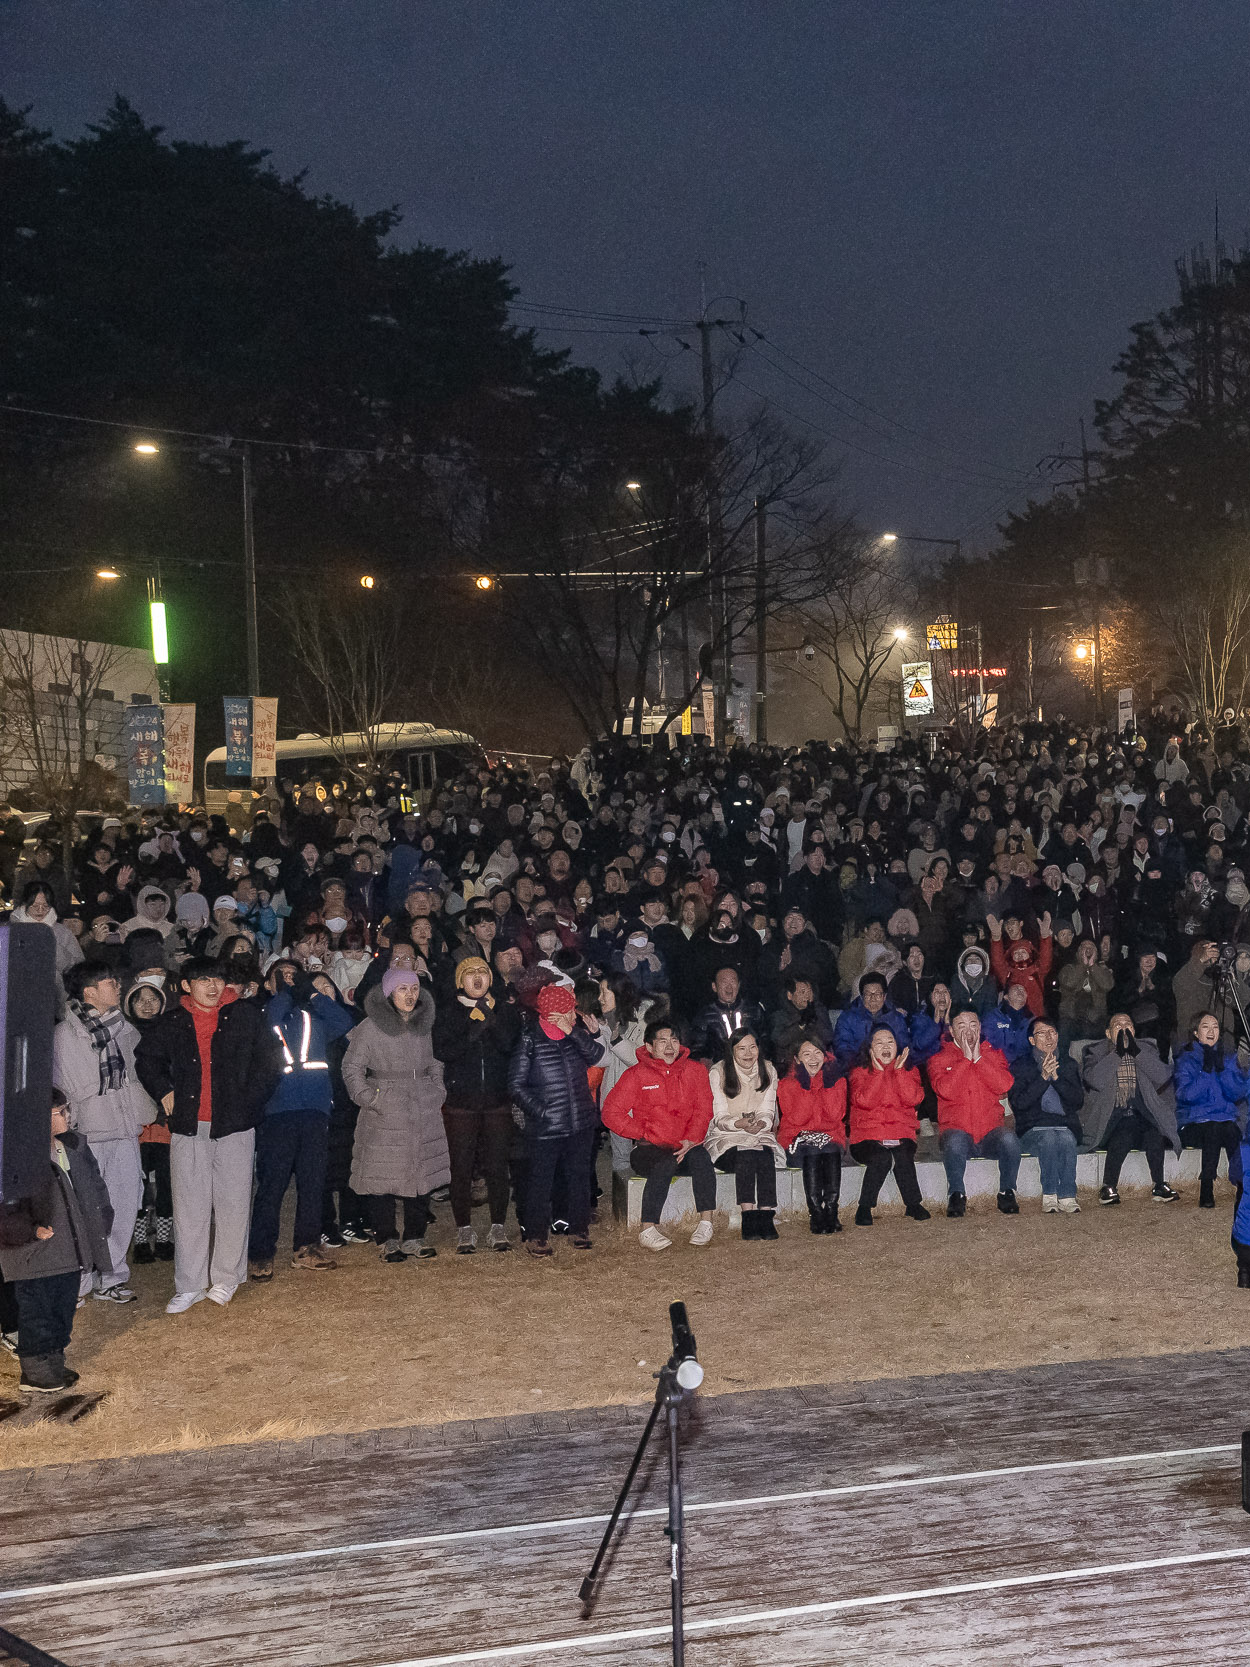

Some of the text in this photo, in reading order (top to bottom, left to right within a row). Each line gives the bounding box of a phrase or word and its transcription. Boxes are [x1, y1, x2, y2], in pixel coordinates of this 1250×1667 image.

[129, 714, 158, 727] 2024
[229, 717, 248, 726] 새해
[130, 730, 158, 742] 새해
[139, 747, 149, 766] 복
[166, 759, 192, 774] 새해
[136, 768, 155, 778] 많이
[129, 778, 164, 788] 받으세요
